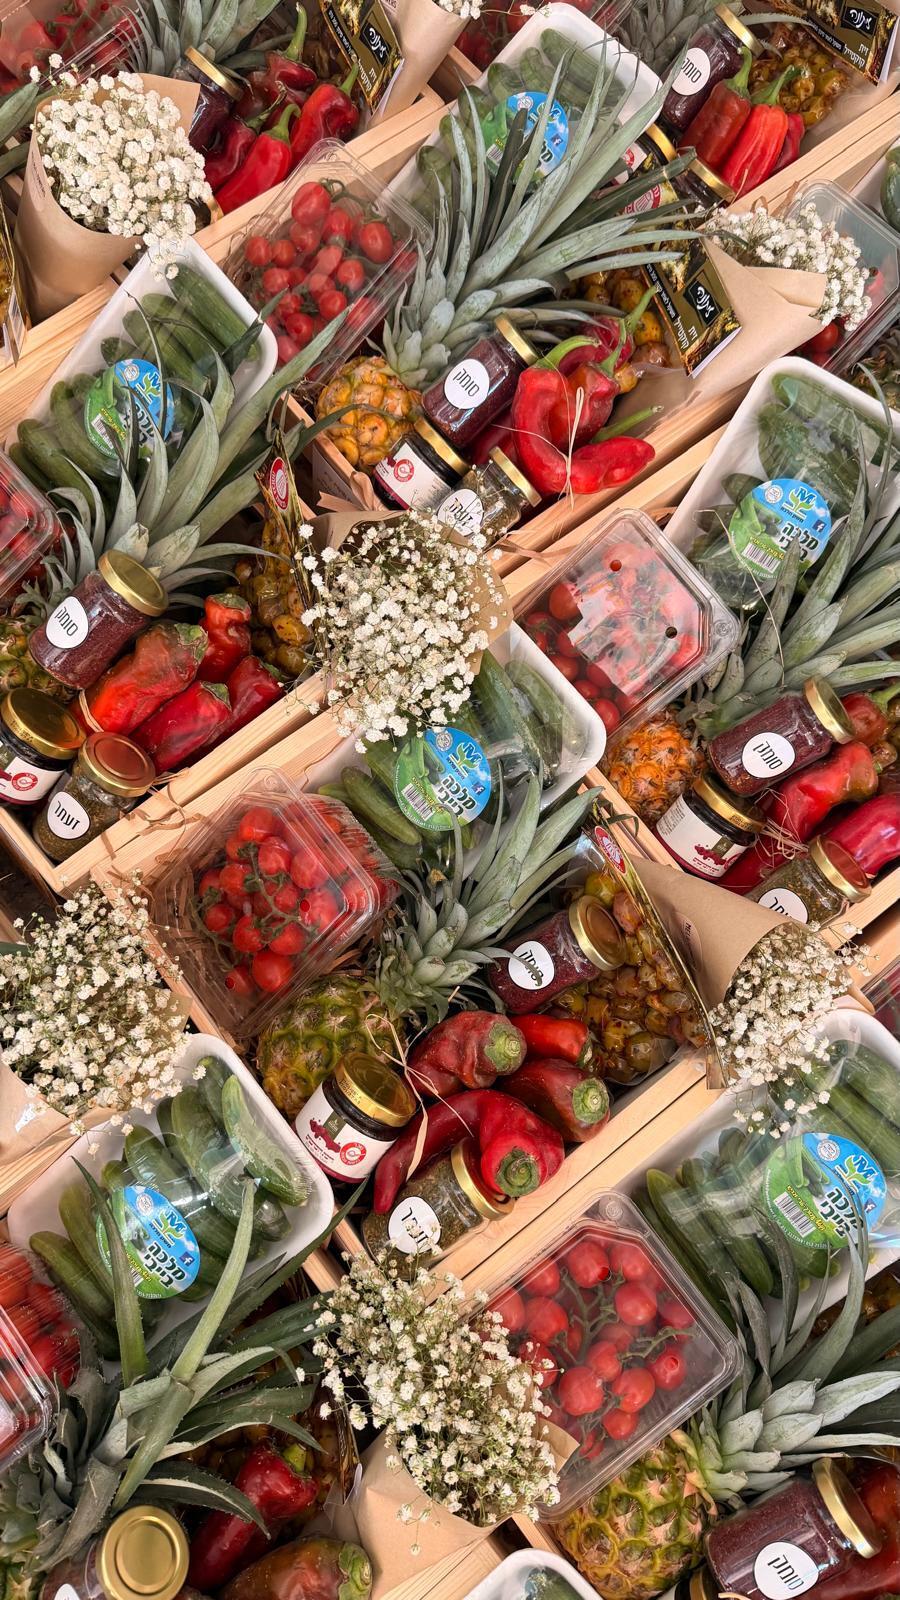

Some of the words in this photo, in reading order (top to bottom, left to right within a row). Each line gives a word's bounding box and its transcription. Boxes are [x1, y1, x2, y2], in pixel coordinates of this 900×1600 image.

[858, 43, 869, 55] זית
[688, 325, 698, 340] זית
[452, 367, 480, 397] סומק
[54, 606, 79, 637] סומק
[752, 740, 783, 770] סומק
[438, 786, 464, 817] בייבי
[441, 774, 477, 811] מלכה
[53, 800, 81, 831] זעתר
[820, 1201, 851, 1237] בייבי
[144, 1253, 174, 1288] בייבי
[148, 1241, 186, 1281] מלכה
[767, 1554, 805, 1590] סומק
